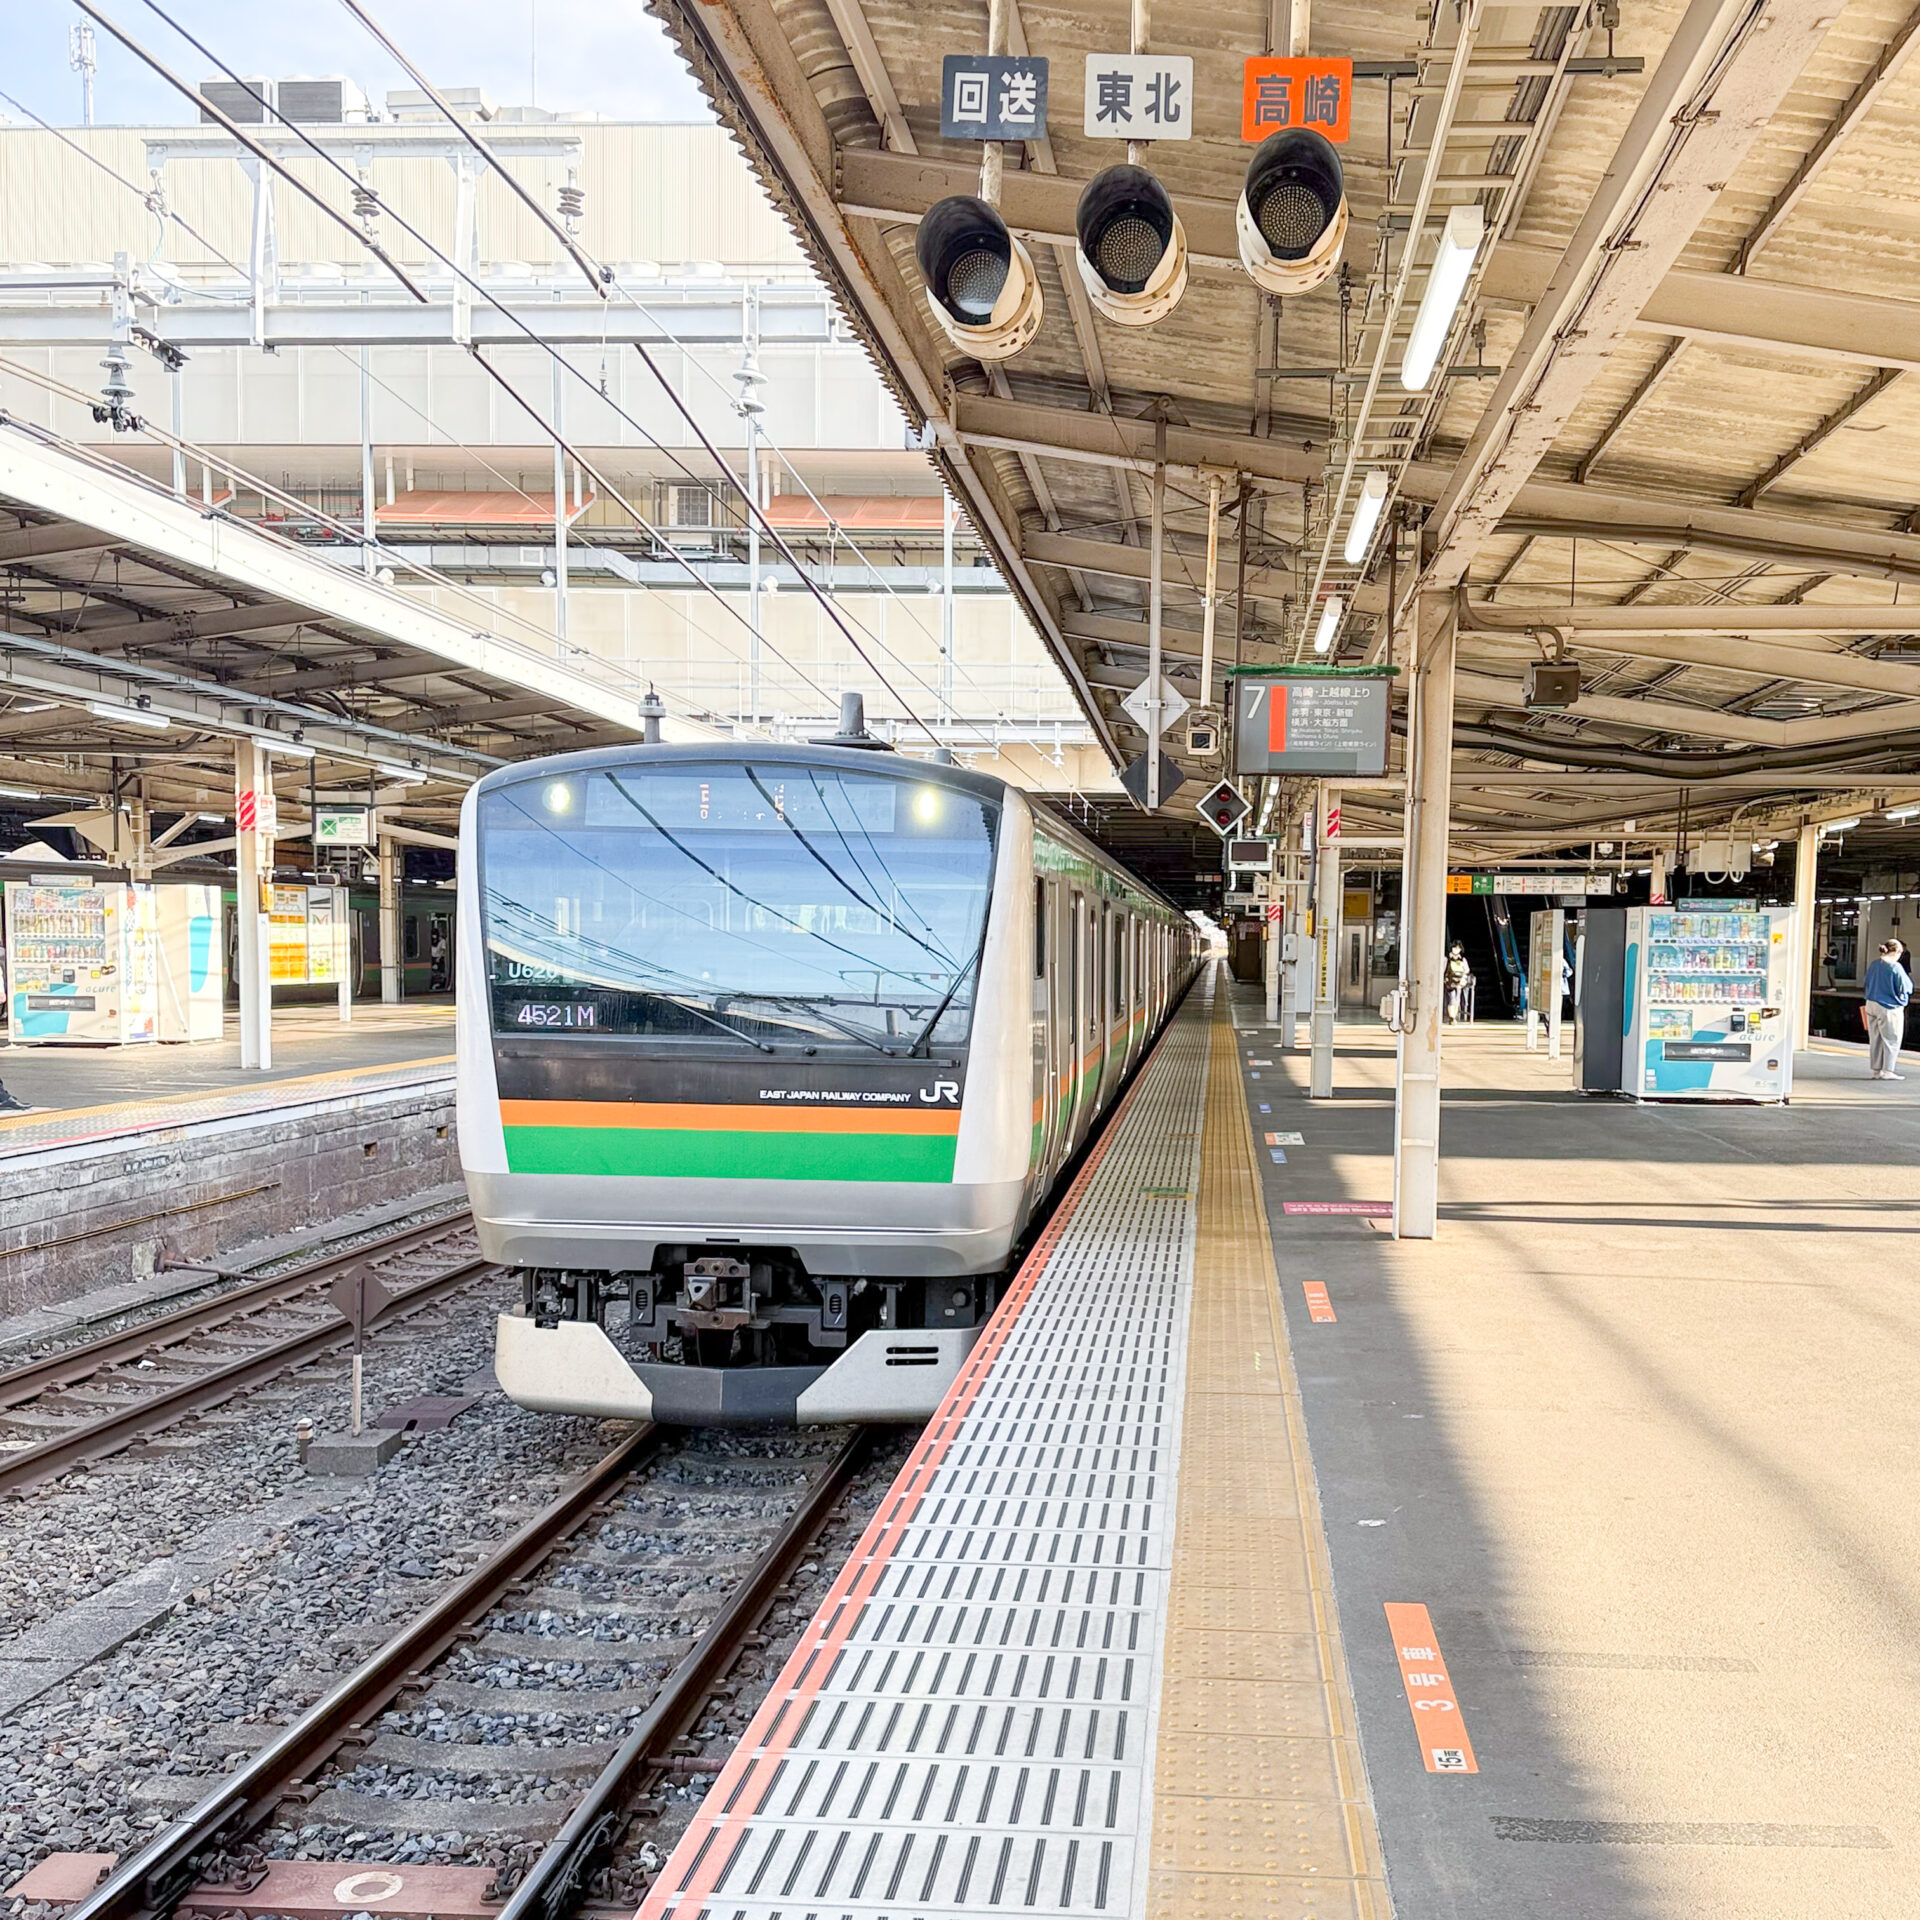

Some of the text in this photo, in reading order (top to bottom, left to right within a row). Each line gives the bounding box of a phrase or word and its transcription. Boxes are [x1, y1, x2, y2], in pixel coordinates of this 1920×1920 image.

[952, 71, 1037, 124] 回送
[1096, 71, 1182, 124] 東北
[1254, 74, 1341, 127] 高崎
[1244, 686, 1266, 719] 7
[517, 1004, 594, 1027] 4521M
[1739, 1033, 1776, 1042] acure
[759, 1090, 911, 1103] EAST JAPAN RAILWAY COMPANY
[919, 1081, 959, 1103] JR
